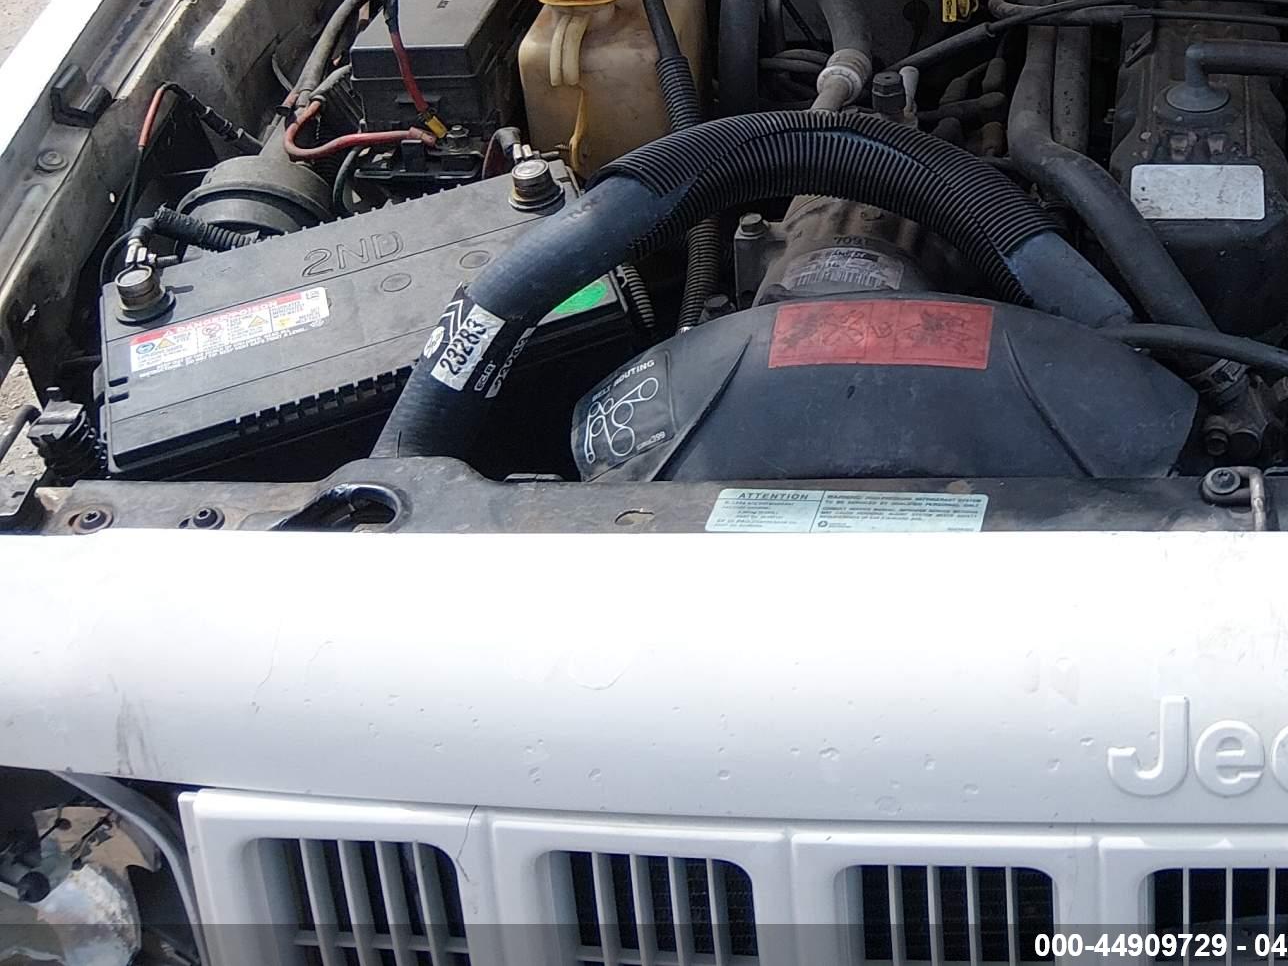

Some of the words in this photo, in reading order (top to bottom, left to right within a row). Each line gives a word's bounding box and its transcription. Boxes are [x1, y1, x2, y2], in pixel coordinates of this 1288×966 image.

[301, 230, 404, 277] 2ND
[440, 318, 487, 376] 23283
[613, 359, 655, 387] ROUTING
[737, 492, 809, 500] ATTENTION
